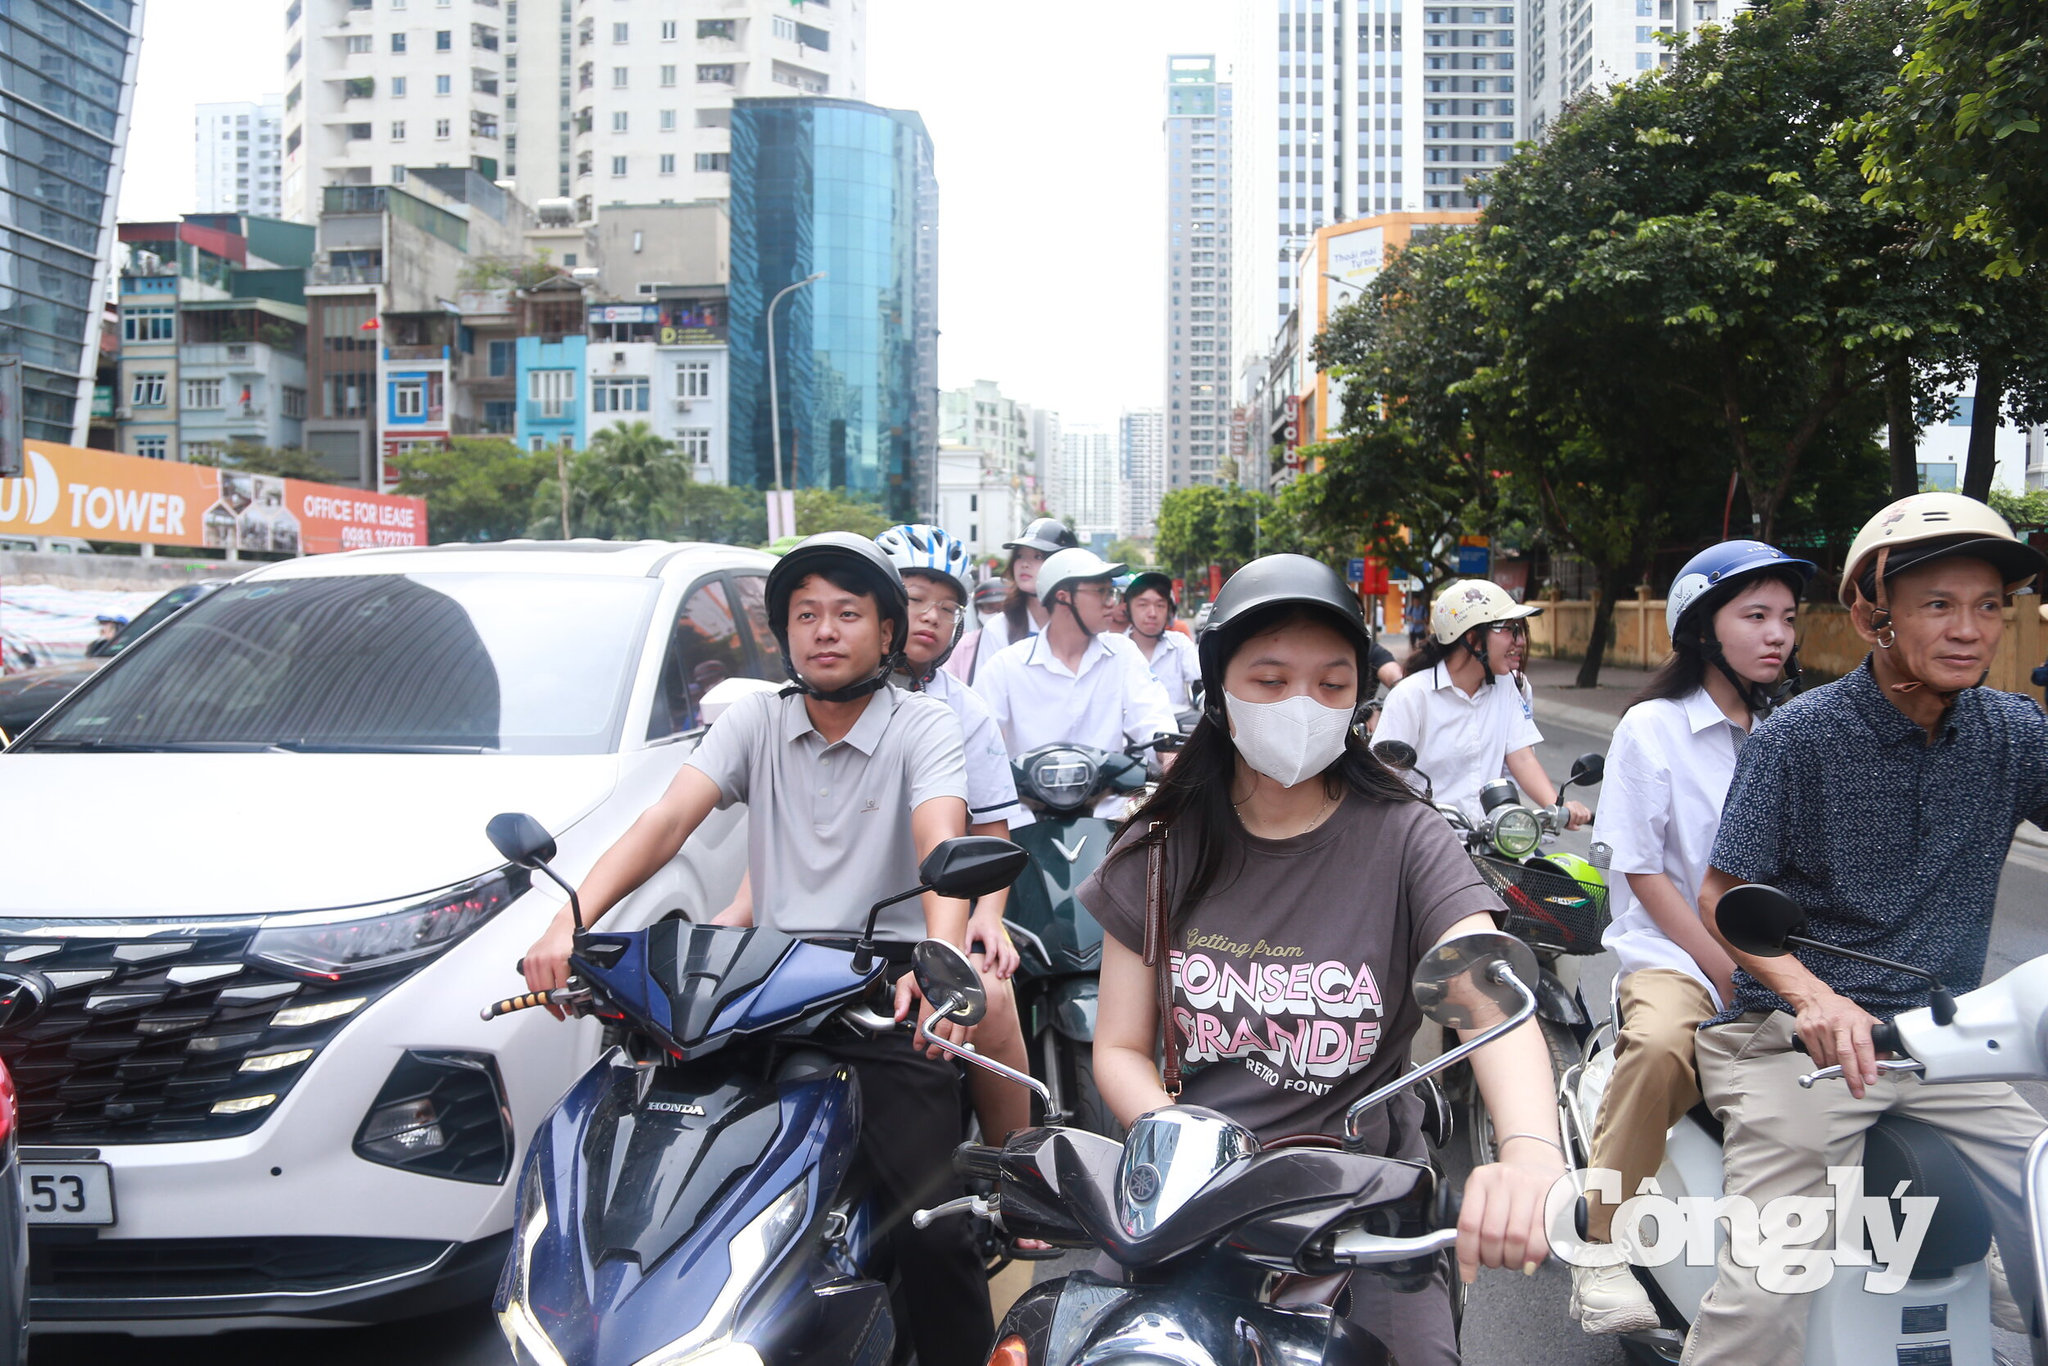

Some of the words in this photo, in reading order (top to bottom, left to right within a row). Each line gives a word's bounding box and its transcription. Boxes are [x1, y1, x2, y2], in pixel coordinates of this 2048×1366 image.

[68, 483, 185, 536] TOWER
[304, 495, 352, 521] OFFICE
[353, 502, 377, 524] FOR
[379, 505, 415, 528] LEASE
[1187, 928, 1250, 958] Getting
[1250, 939, 1304, 958] from
[1173, 1006, 1382, 1077] GRANDE
[1246, 1058, 1279, 1086] RETRO
[1284, 1079, 1333, 1097] FONT
[647, 1102, 705, 1116] HONDA
